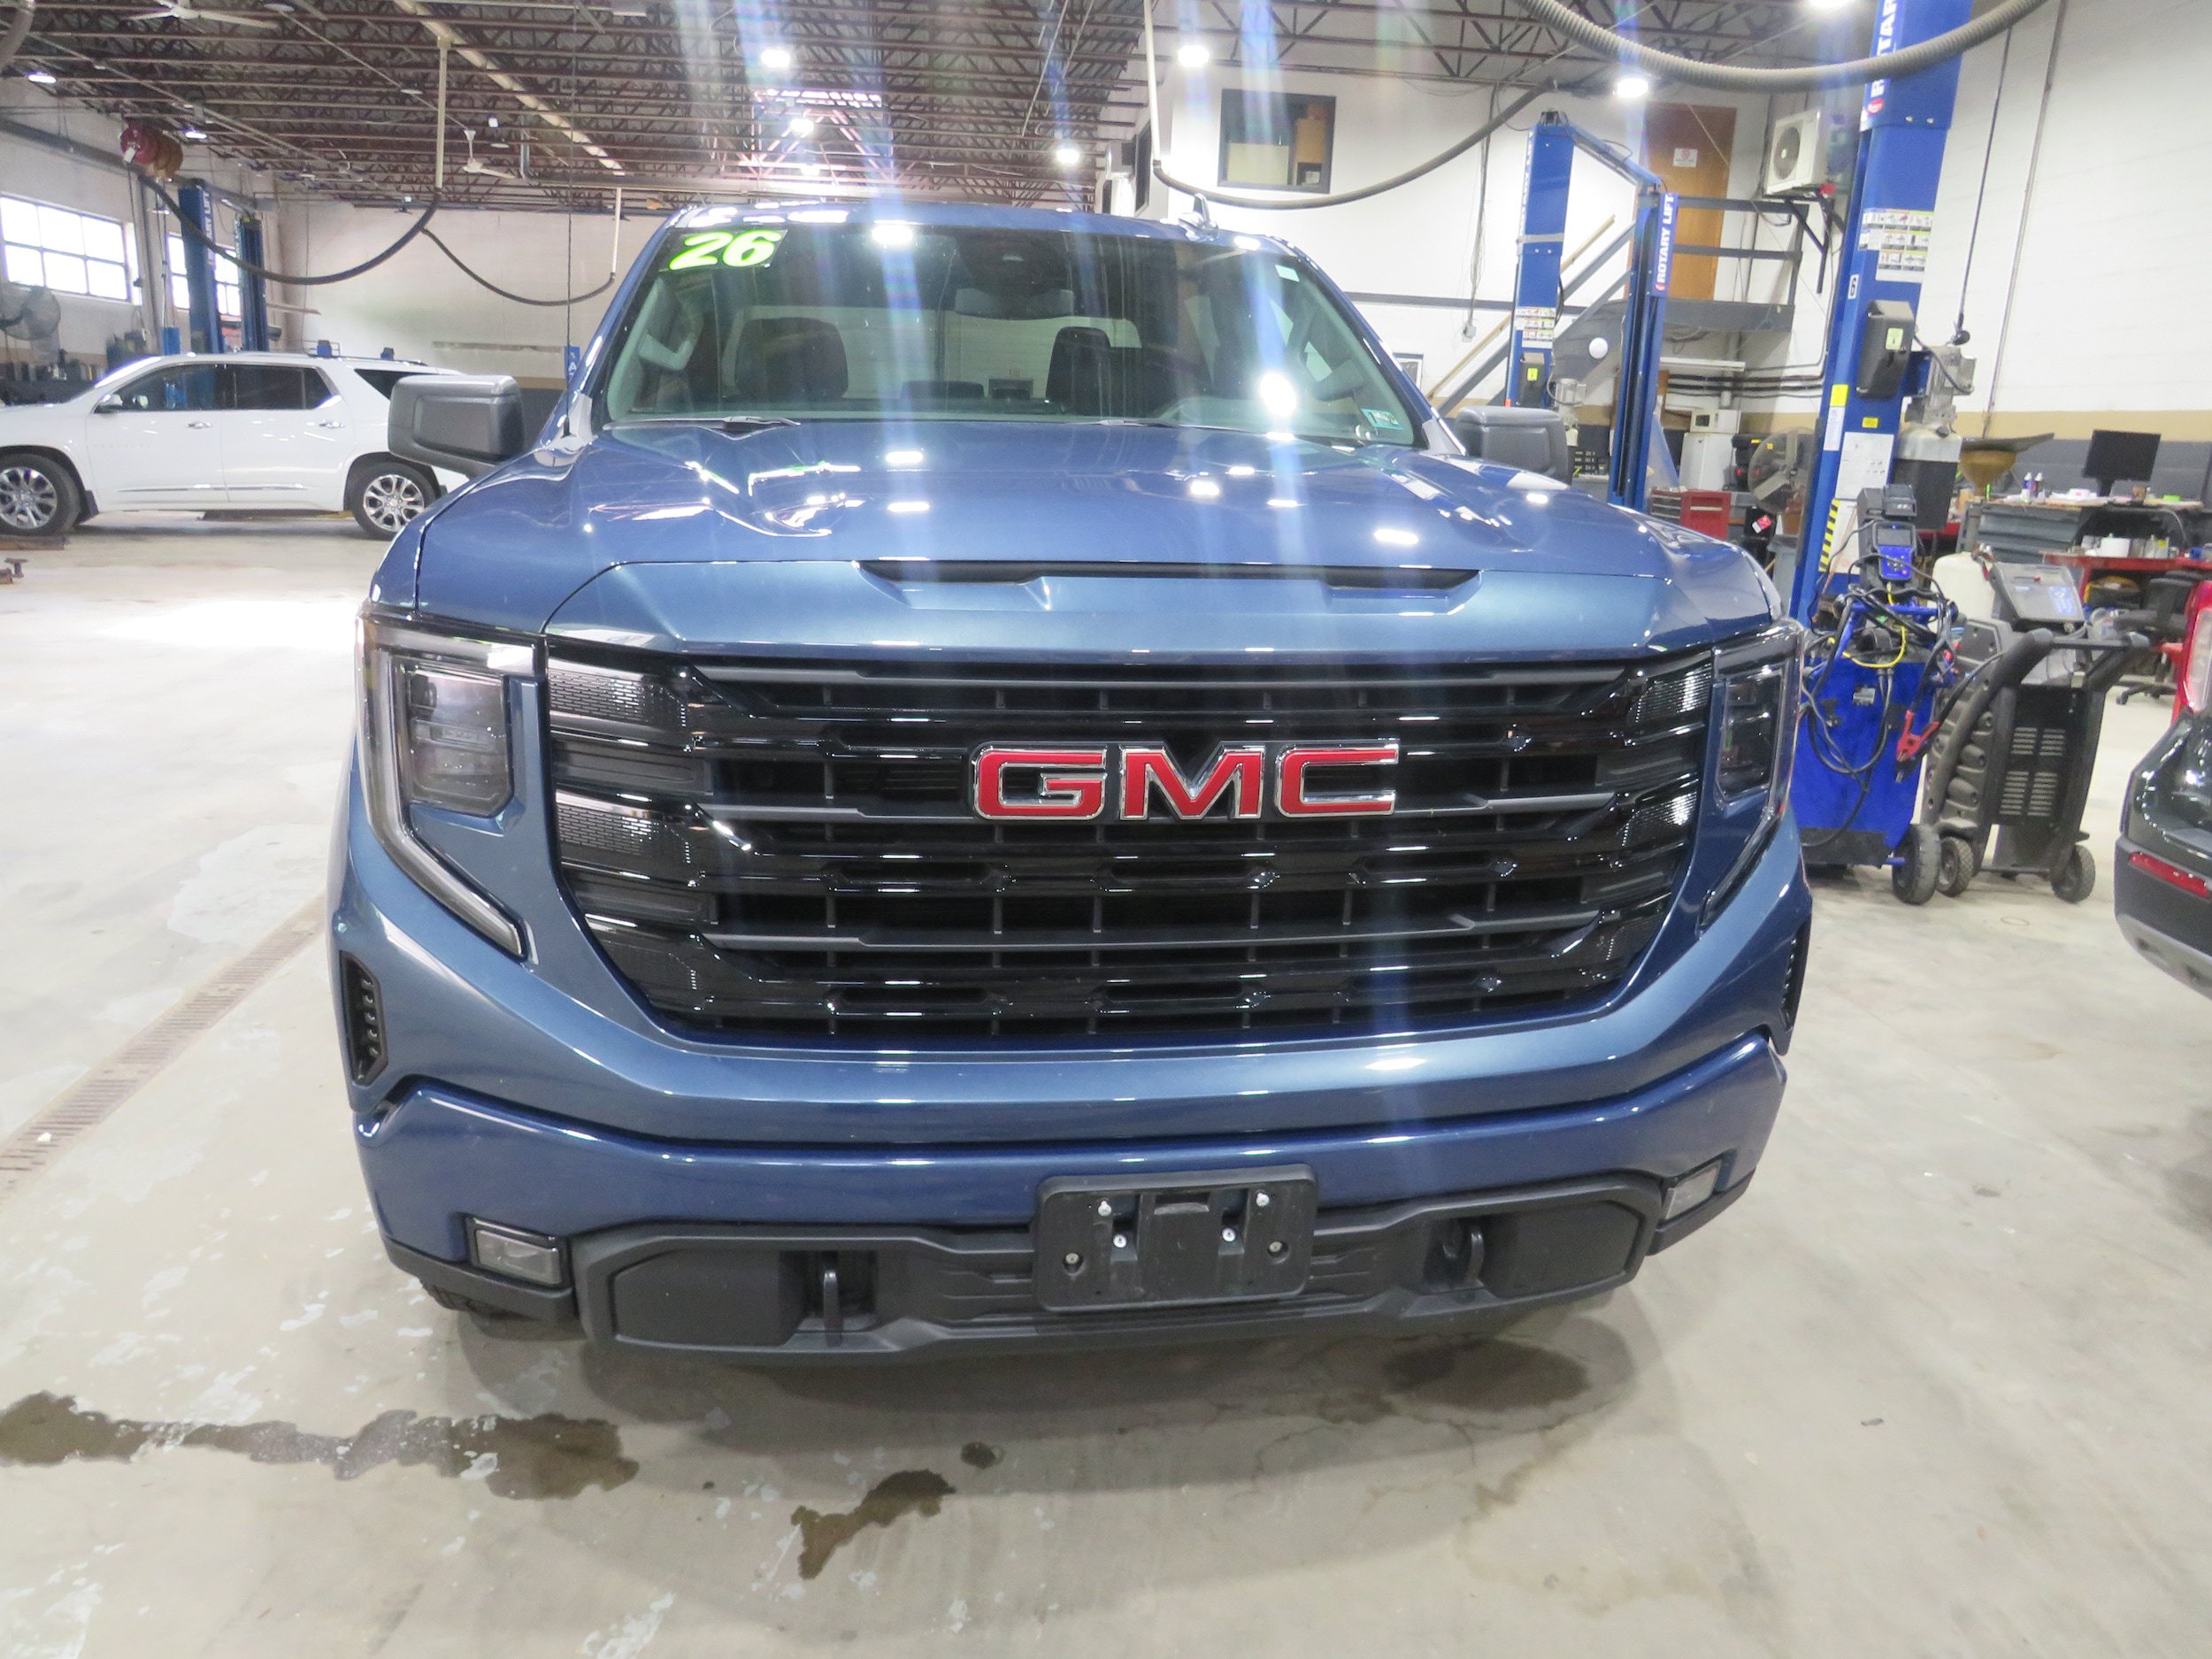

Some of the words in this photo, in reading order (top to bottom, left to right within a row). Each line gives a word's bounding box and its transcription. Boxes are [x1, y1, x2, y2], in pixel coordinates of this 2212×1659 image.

[1663, 193, 1674, 225] LIFT
[669, 231, 782, 270] 26
[1656, 227, 1671, 283] ROTARY
[972, 740, 1400, 821] GMC
